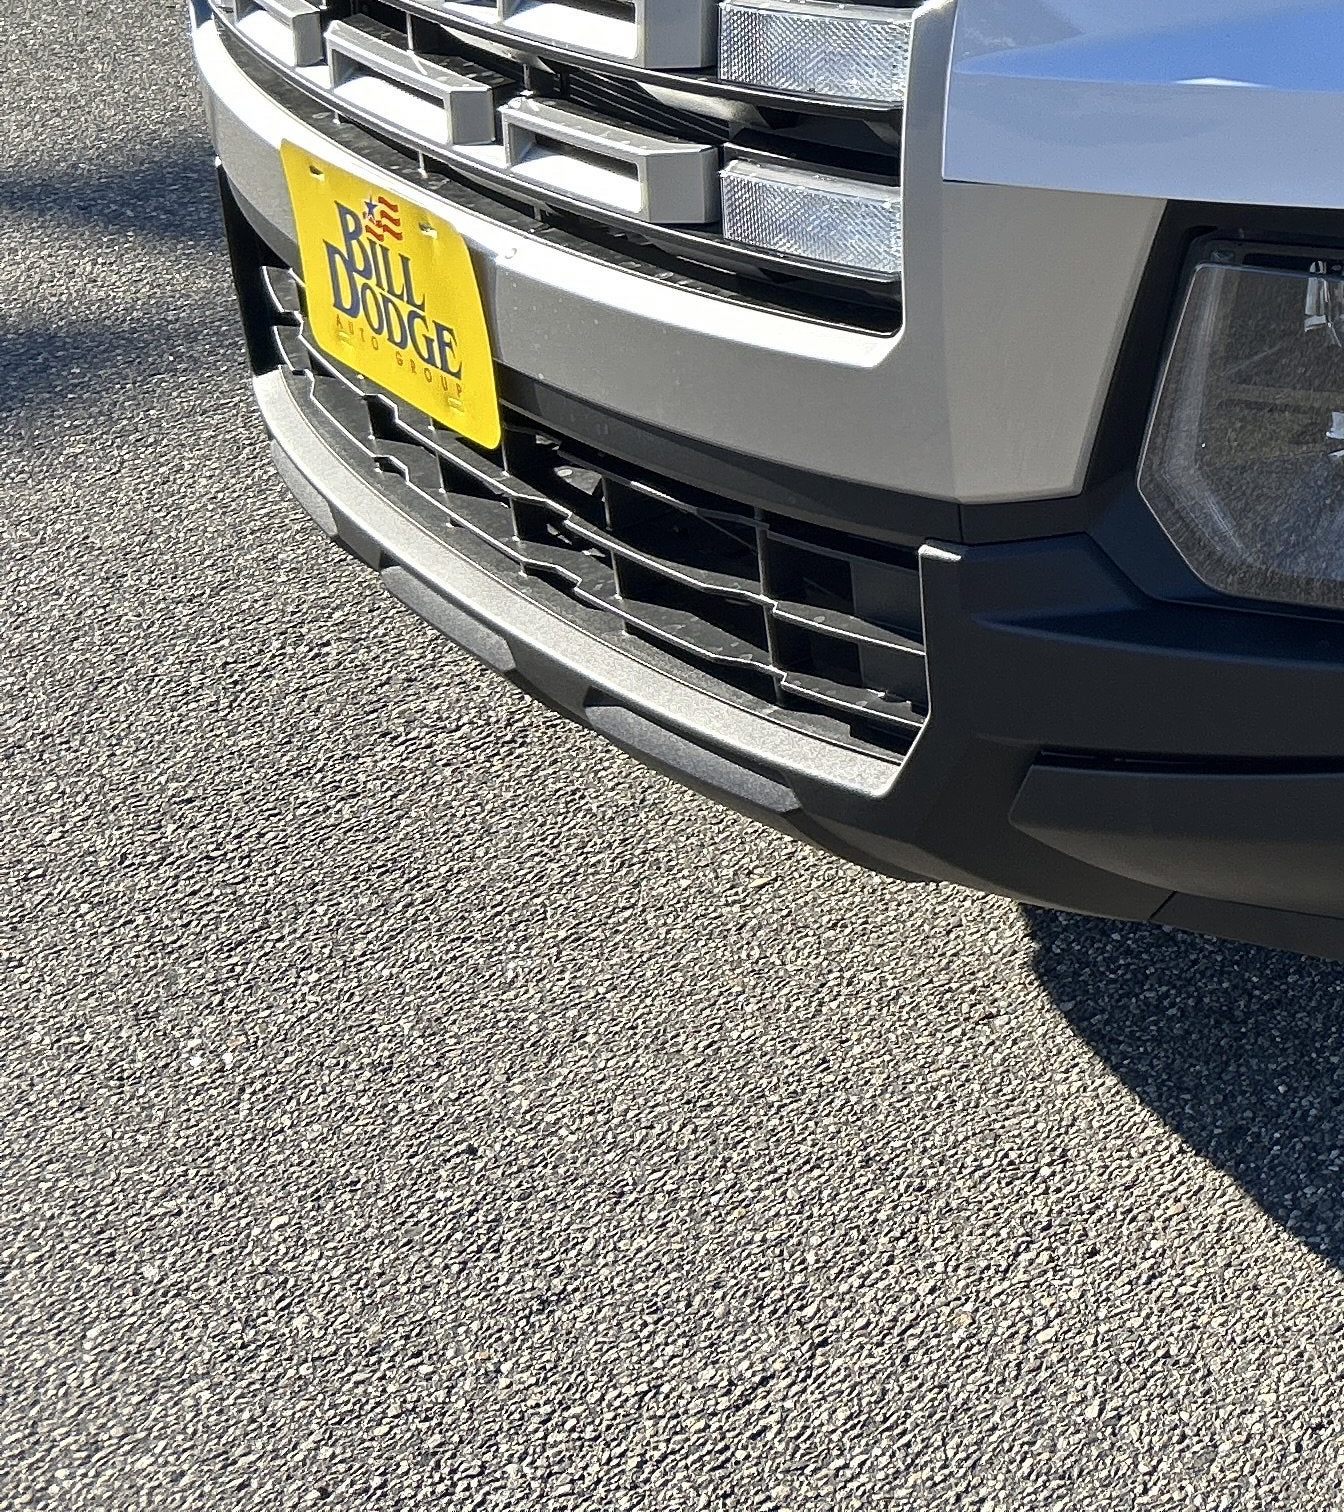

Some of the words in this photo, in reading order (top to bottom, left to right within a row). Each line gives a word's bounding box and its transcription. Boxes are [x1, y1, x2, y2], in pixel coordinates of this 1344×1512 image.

[322, 238, 463, 381] DODGE
[334, 199, 425, 314] BILL
[336, 314, 379, 351] AUTO
[395, 350, 463, 397] GROUP
